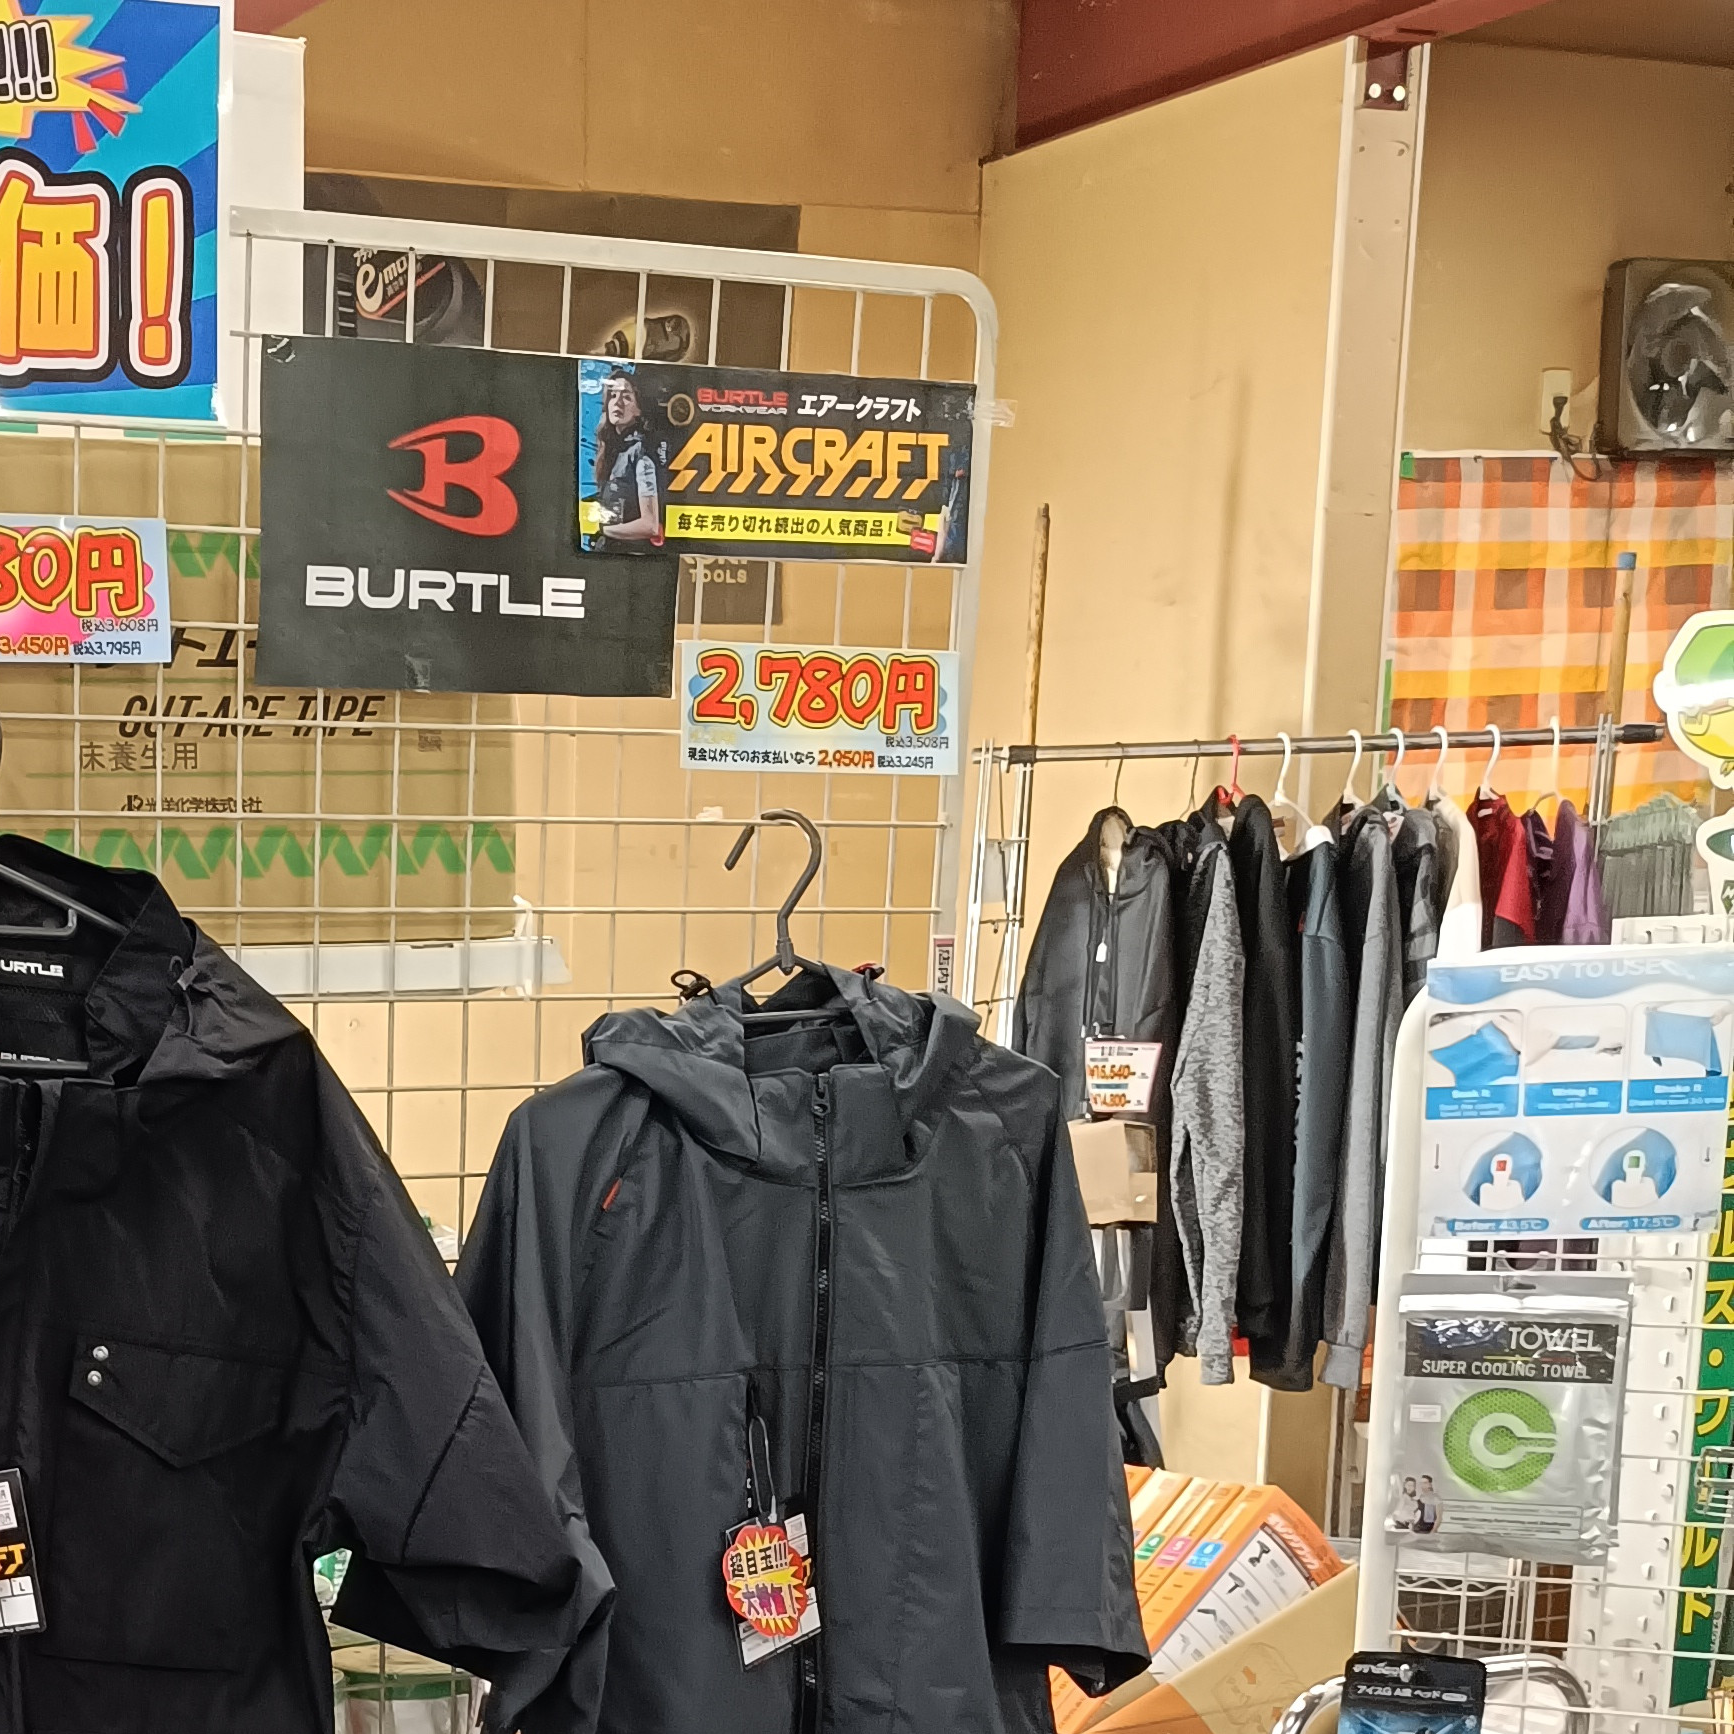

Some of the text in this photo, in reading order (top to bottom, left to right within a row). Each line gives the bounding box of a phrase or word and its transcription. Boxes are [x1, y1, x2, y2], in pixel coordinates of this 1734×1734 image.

[697, 388, 922, 423] BURTLE エアークラフト
[668, 422, 950, 500] AIRCRAFT
[305, 563, 586, 620] BURTLE
[694, 648, 939, 735] 2,780円
[292, 695, 387, 738] TAPE
[78, 741, 199, 772] 床養生用
[817, 749, 876, 769] 2,950円
[1499, 958, 1661, 983] EASY TO USE
[1508, 1324, 1603, 1352] TOWEL
[1422, 1359, 1591, 1379] SUPER COOLING TOWEL
